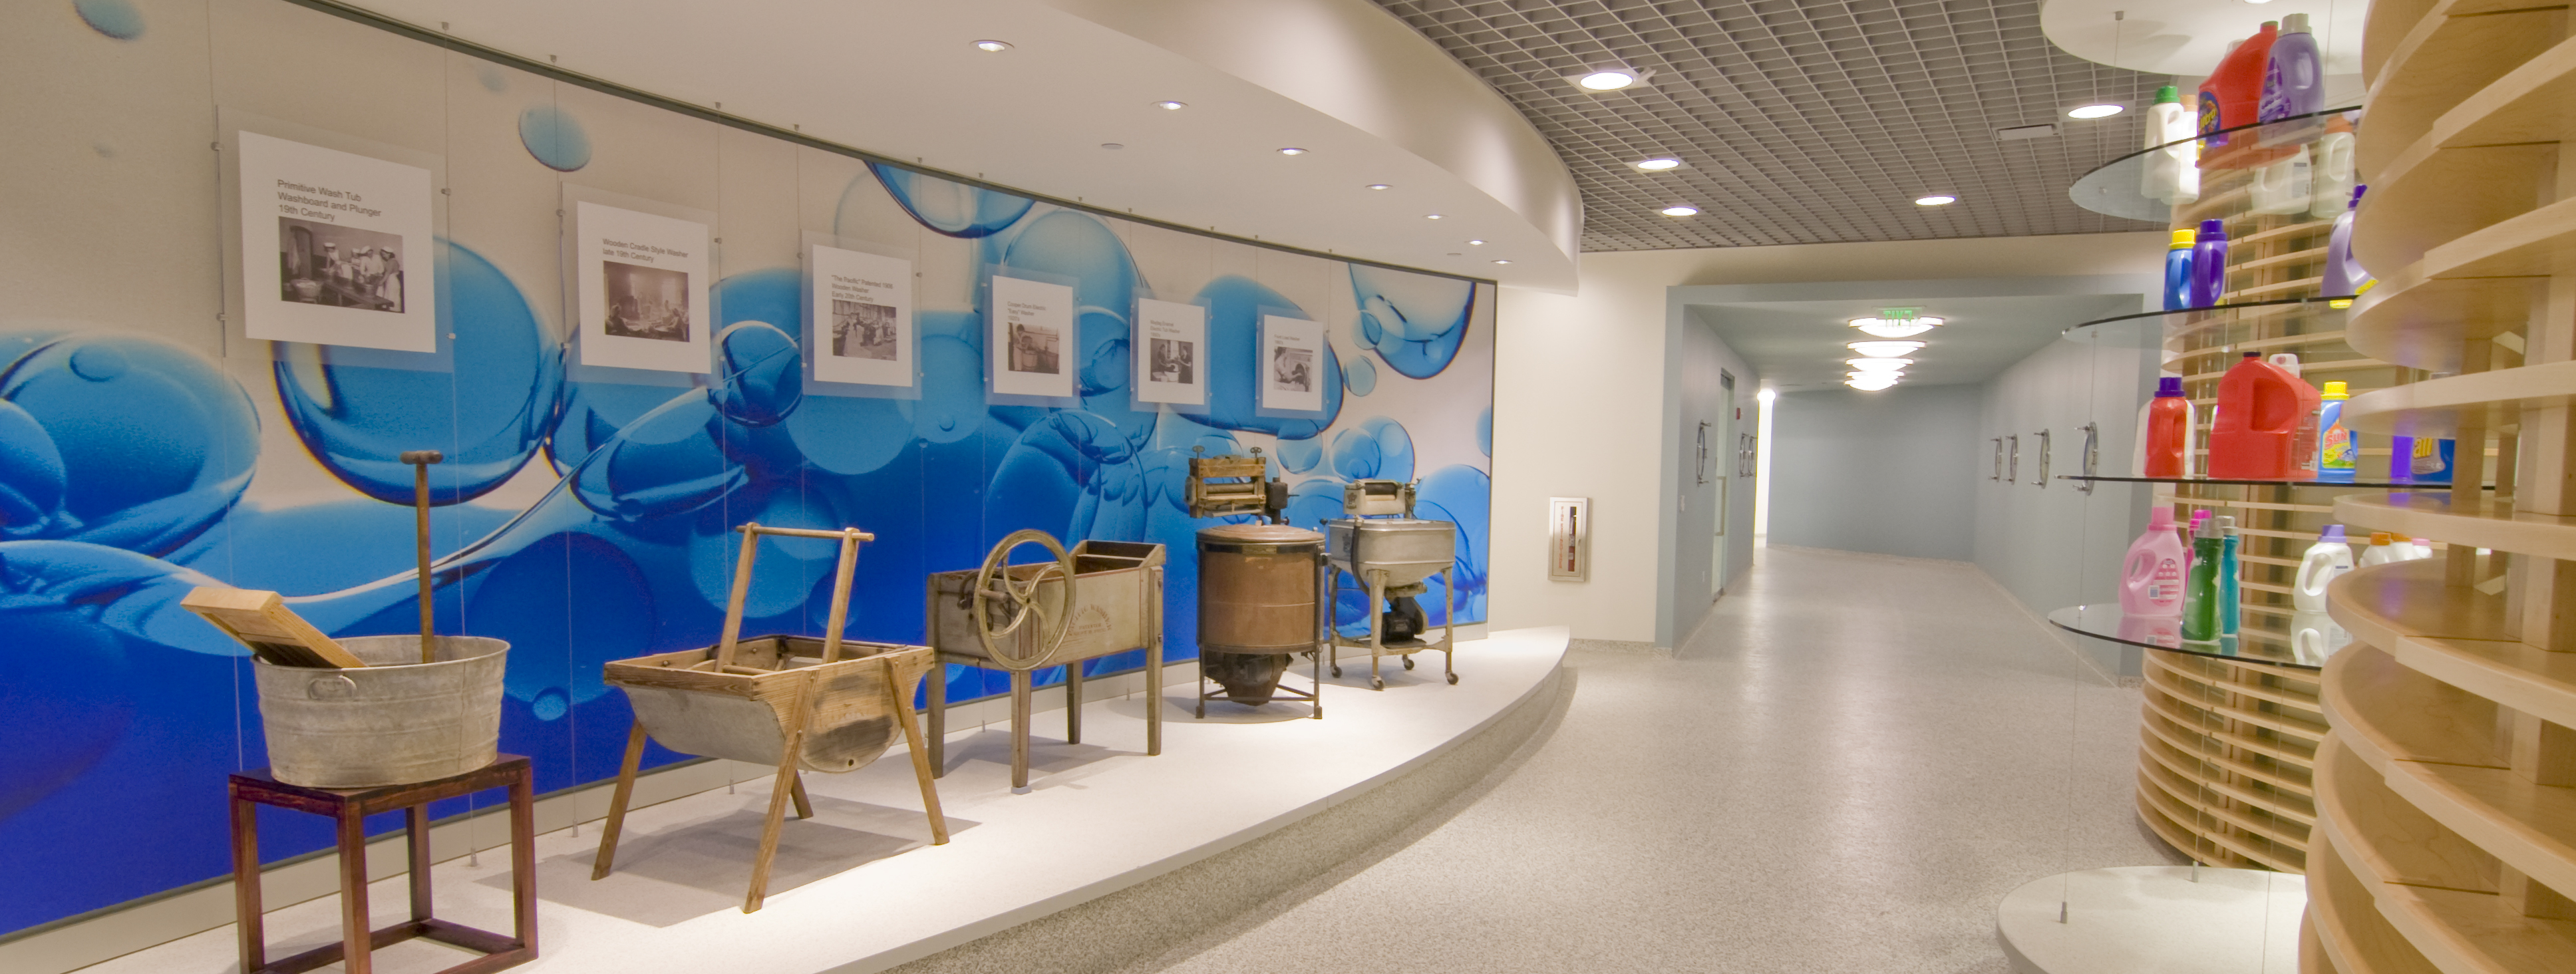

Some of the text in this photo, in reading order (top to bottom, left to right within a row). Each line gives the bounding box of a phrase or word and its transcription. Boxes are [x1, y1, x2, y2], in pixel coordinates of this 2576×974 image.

[277, 179, 361, 202] Primitive Wash Tub
[277, 192, 381, 217] Washboard and Plunger
[278, 204, 335, 222] 19th Century
[602, 238, 689, 258] Wooden Cradle Style Washer
[631, 252, 655, 263] Century
[2414, 438, 2432, 458] all
